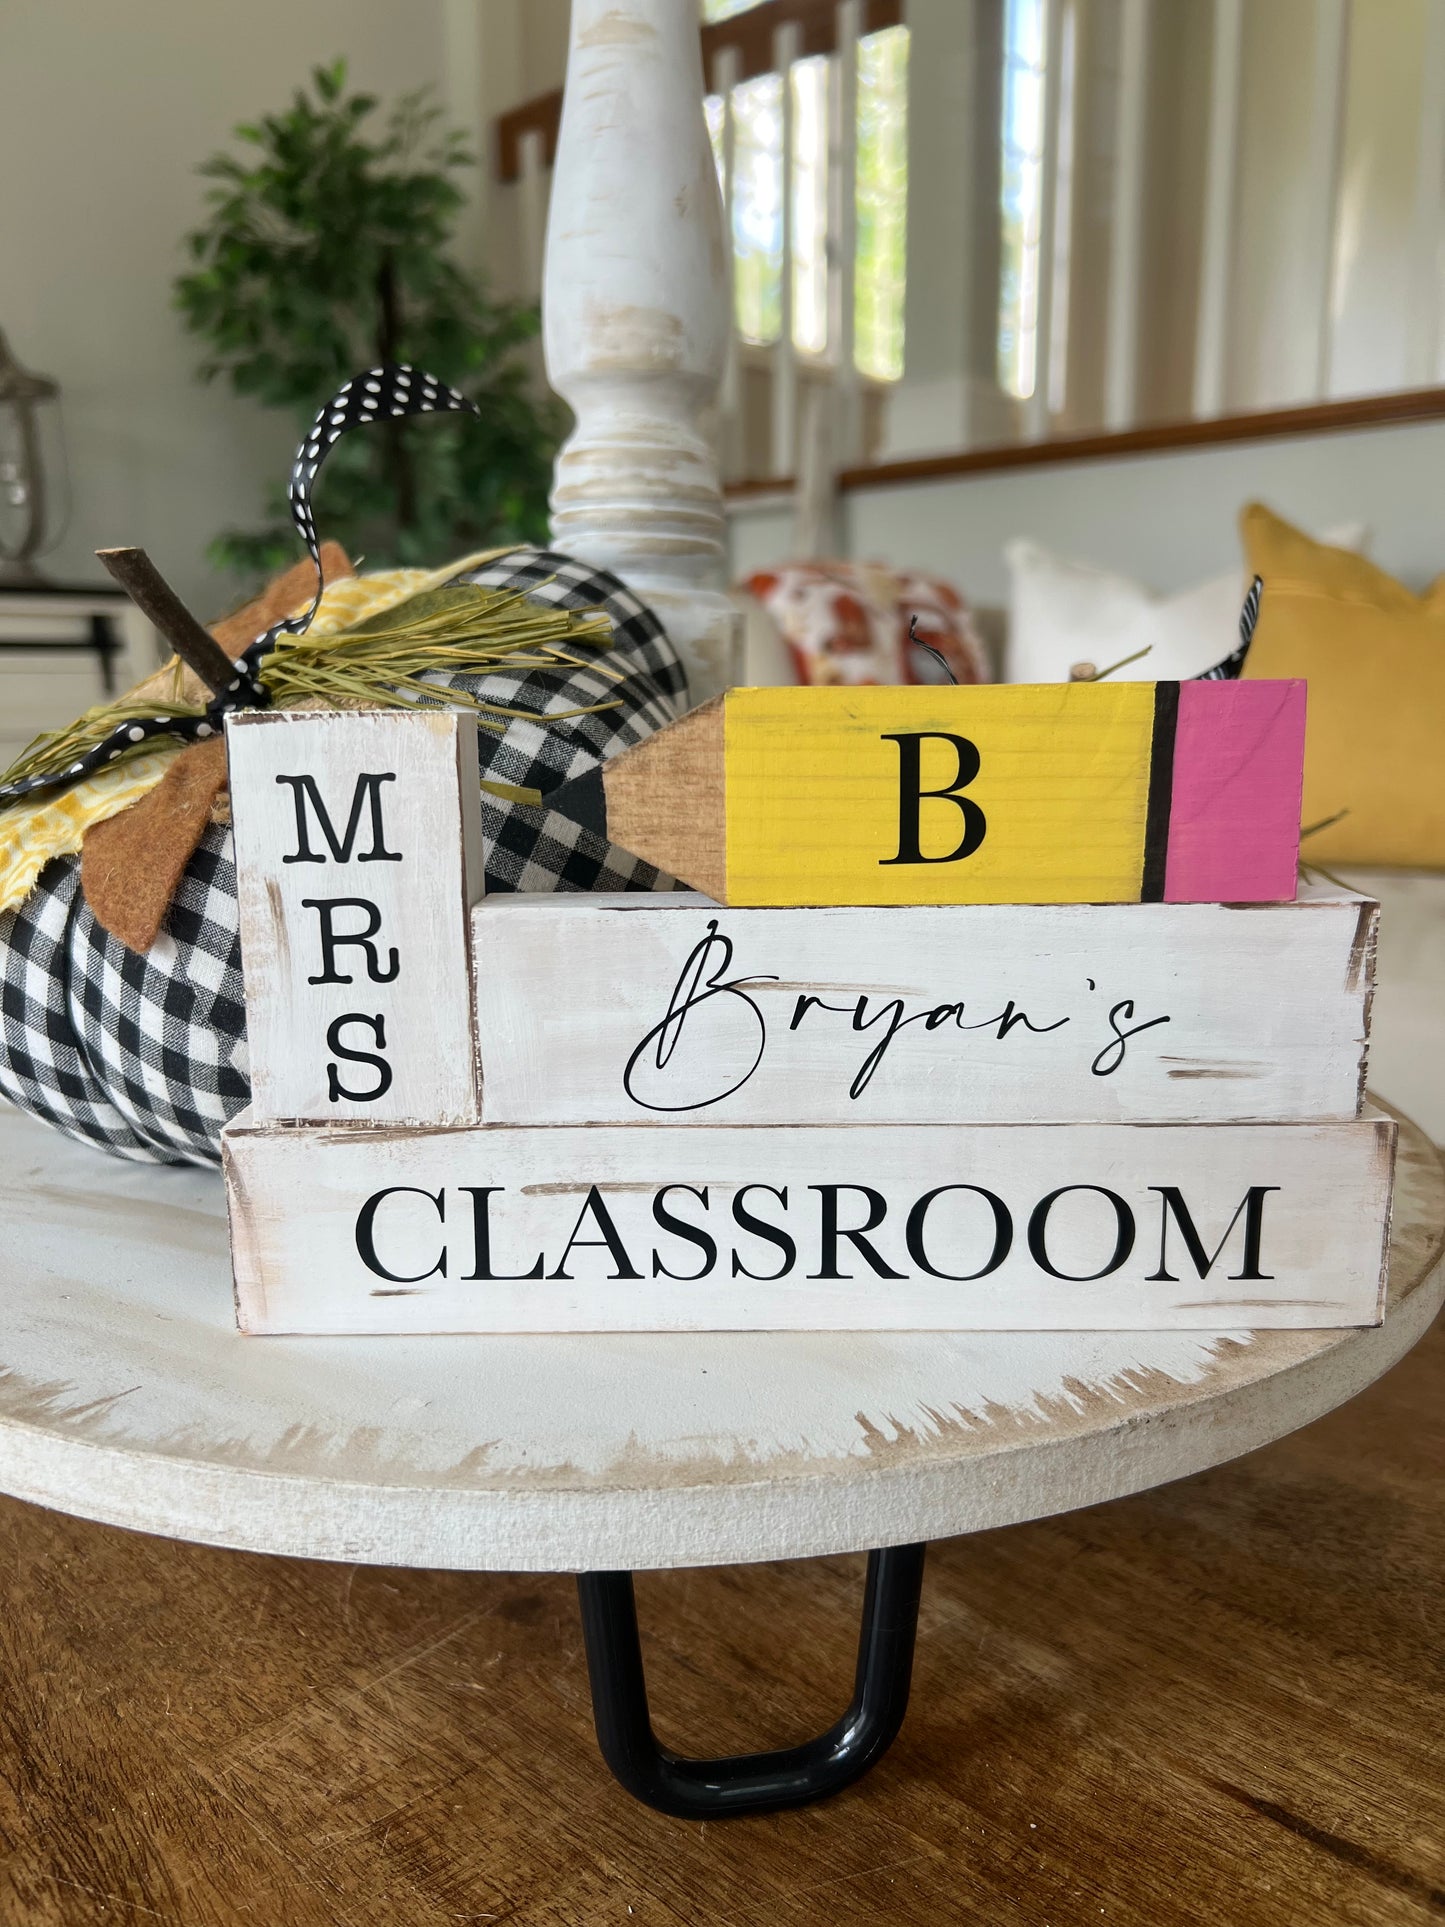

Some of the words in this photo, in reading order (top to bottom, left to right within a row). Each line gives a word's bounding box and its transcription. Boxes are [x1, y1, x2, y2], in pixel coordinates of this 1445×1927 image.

[879, 732, 986, 865] B
[276, 773, 402, 1103] MRS
[623, 919, 1170, 1112] Bryan's
[355, 1184, 1282, 1282] CLASSROOM
